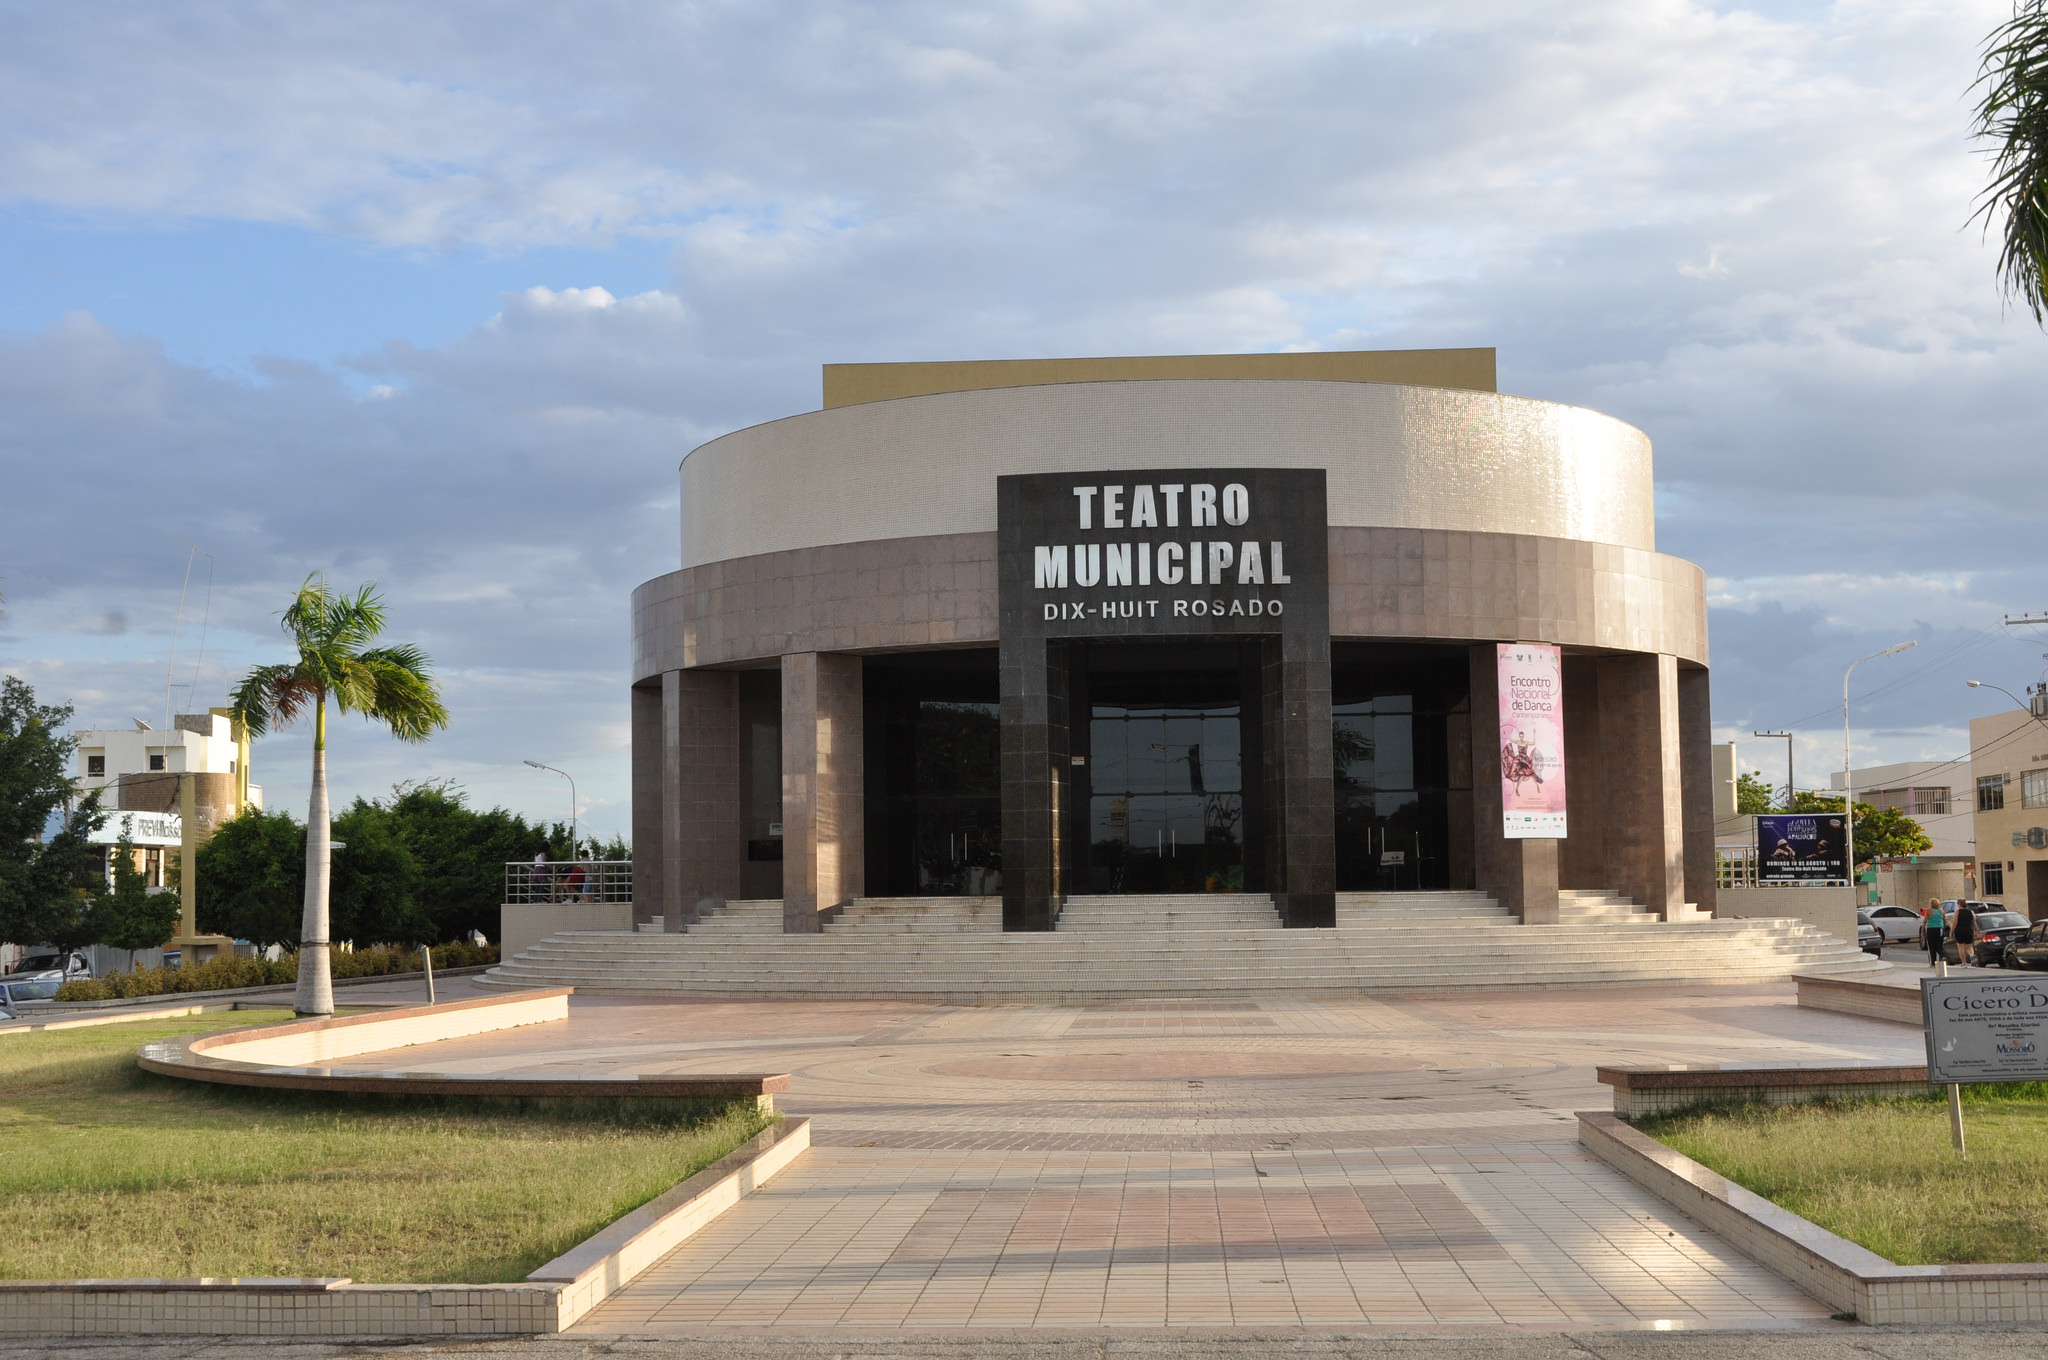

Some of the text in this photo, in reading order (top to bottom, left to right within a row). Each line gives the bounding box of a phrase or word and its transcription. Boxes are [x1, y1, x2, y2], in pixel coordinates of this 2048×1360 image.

[1073, 483, 1249, 529] TEATRO
[1034, 541, 1291, 588] MUNICIPAL
[1044, 600, 1284, 621] DIX-HUIT ROSADO
[1511, 676, 1551, 688] Encontro
[1511, 687, 1551, 699] Nacional
[1512, 700, 1552, 712] de Dança
[1981, 985, 2039, 993] PRAÇA
[1943, 996, 2020, 1011] Cícero
